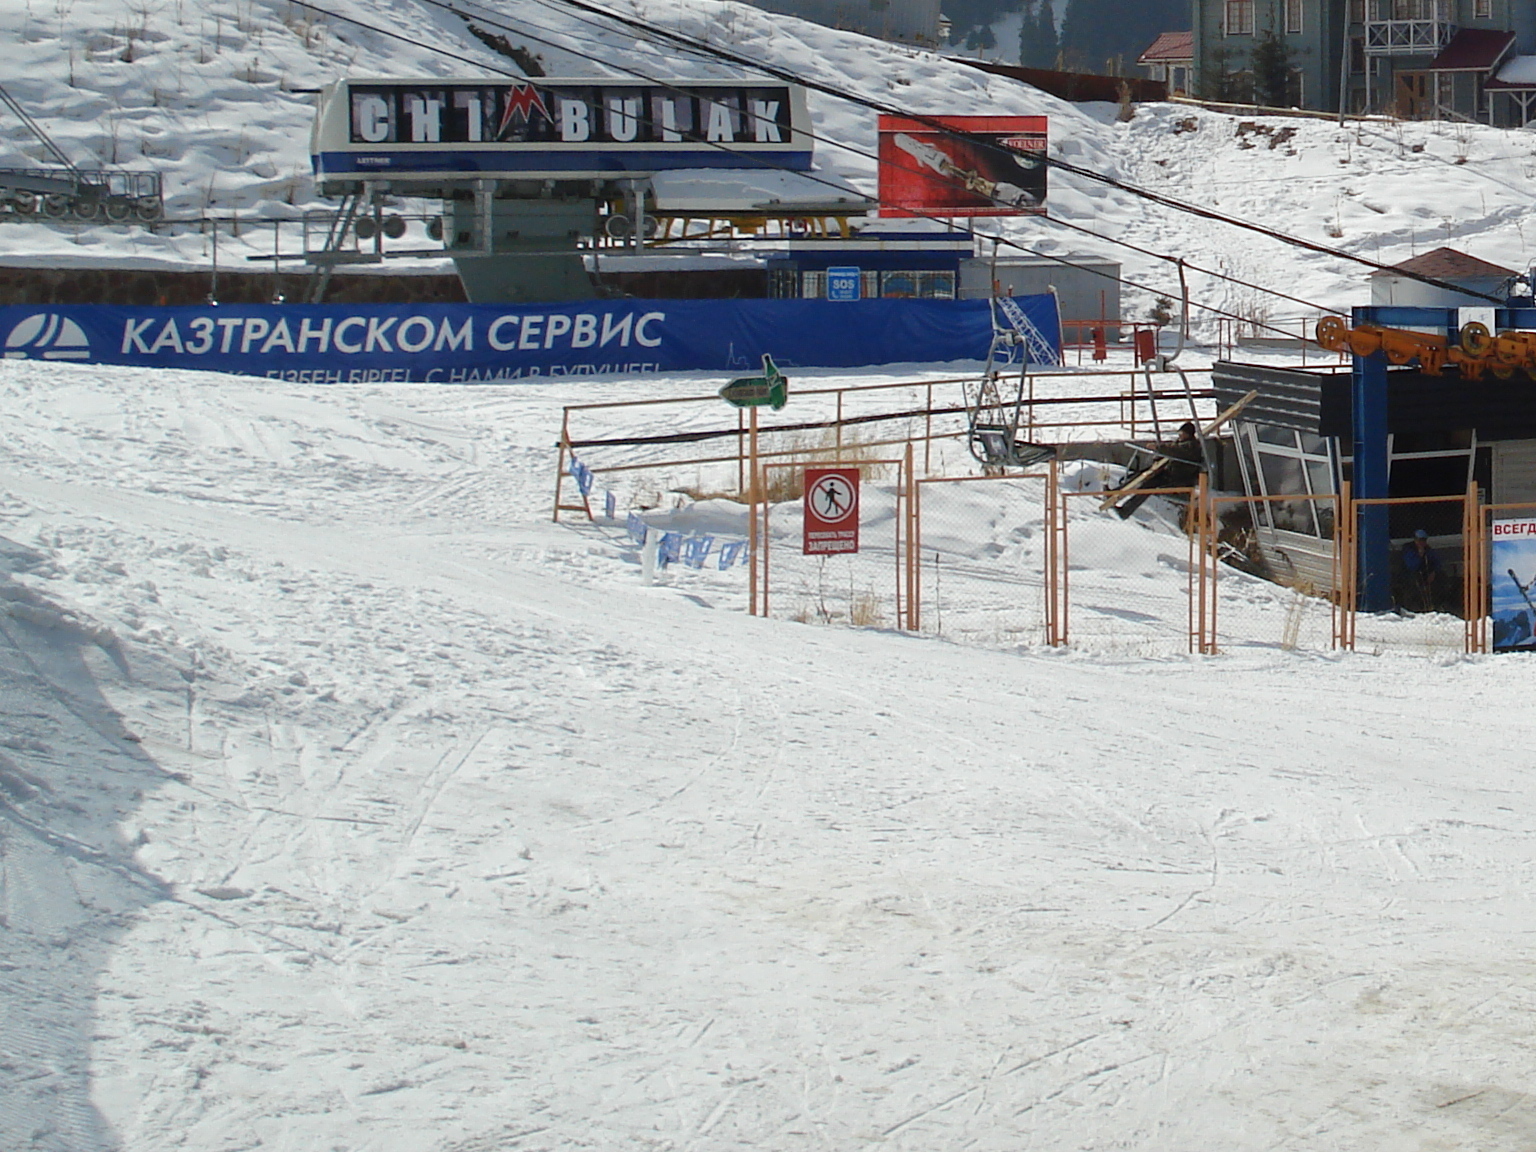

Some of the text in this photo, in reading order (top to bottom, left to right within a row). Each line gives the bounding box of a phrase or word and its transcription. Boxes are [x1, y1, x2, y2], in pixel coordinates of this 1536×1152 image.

[832, 279, 855, 290] SOS
[120, 311, 666, 355] КАЗТРАНСКОМ СЕРВИС
